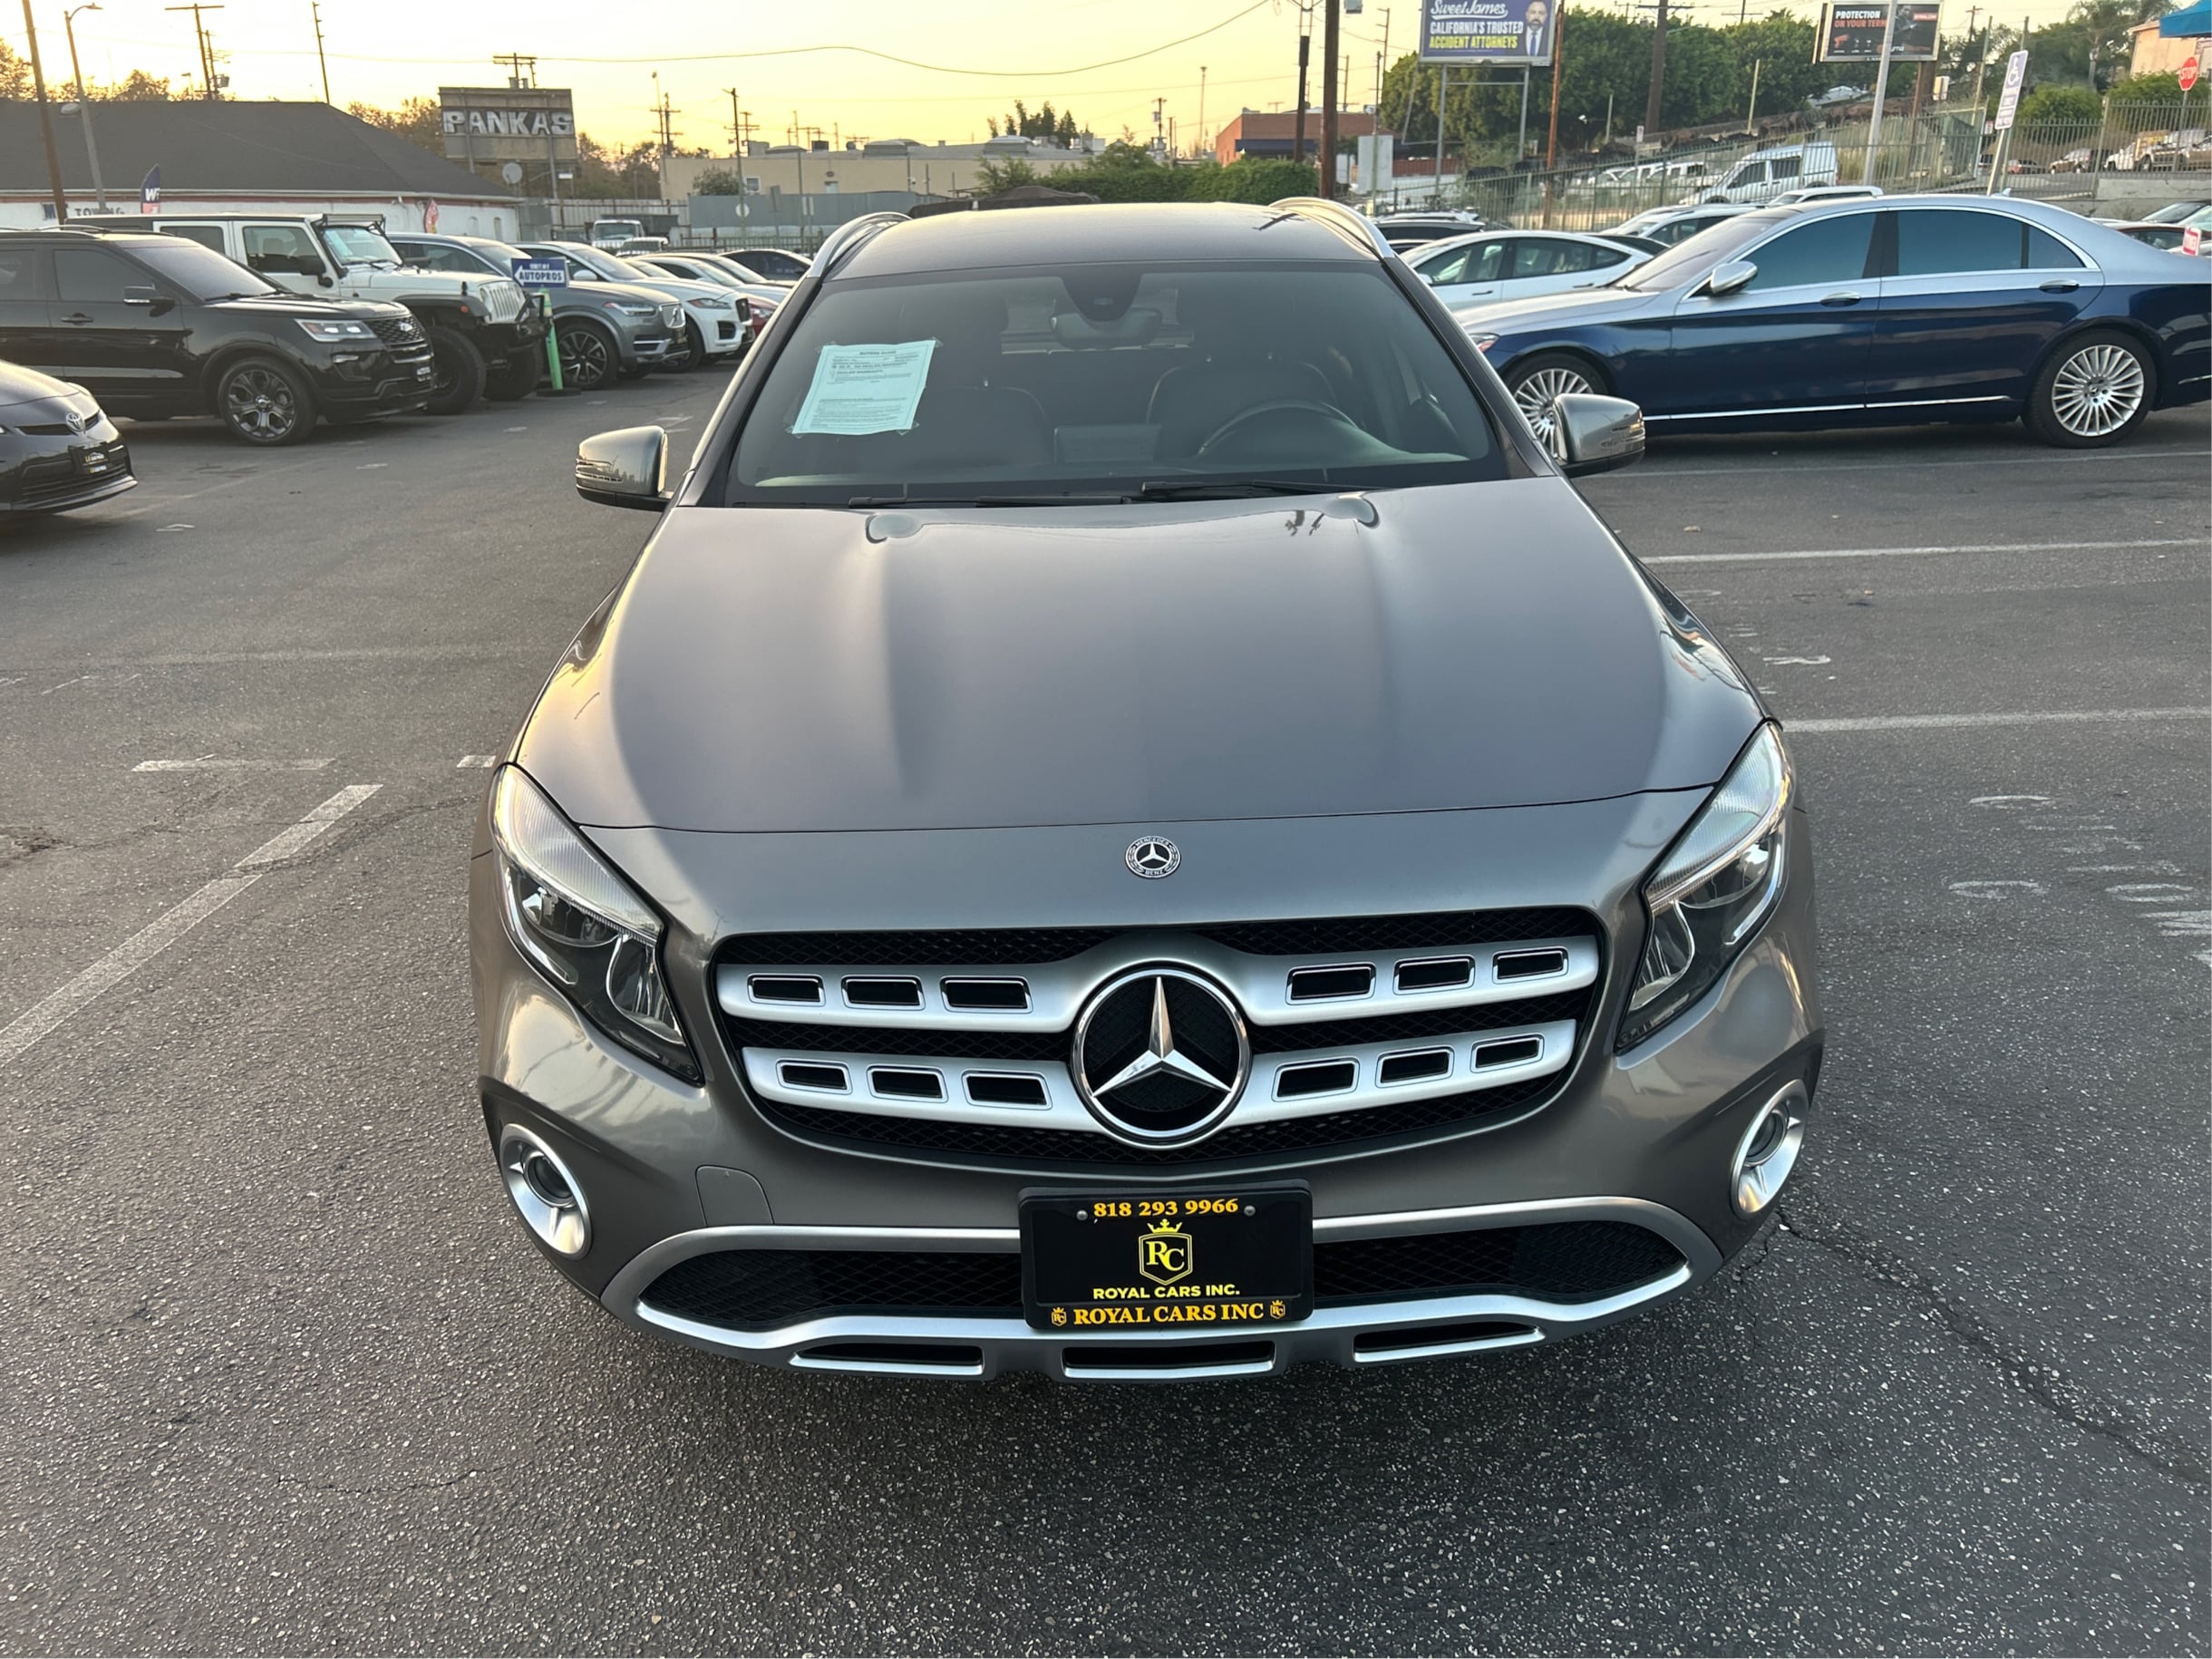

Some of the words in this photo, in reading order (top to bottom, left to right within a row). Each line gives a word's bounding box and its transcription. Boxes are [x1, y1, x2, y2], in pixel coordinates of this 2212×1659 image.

[1431, 0, 1468, 15] Sweet
[1465, 0, 1507, 15] James
[1835, 10, 1881, 20] PROTECTION
[1430, 21, 1485, 34] CALIFORNIA'S
[1487, 20, 1523, 34] TRUSTED
[1834, 20, 1846, 28] ON
[1847, 19, 1867, 28] YOUR
[1429, 36, 1469, 49] ACCIDENT
[1470, 35, 1518, 49] ATTORNEYS
[2180, 66, 2197, 81] STOP
[442, 110, 574, 135] PANKAS
[519, 271, 562, 281] AUTOPROS
[1093, 1201, 1132, 1218] 818
[1139, 1200, 1179, 1217] 293
[1185, 1198, 1239, 1215] 9966
[1146, 1240, 1185, 1271] RC
[1092, 1287, 1150, 1300] ROYAL
[1154, 1285, 1201, 1298] CARS
[1206, 1284, 1241, 1296] INC.
[1073, 1306, 1150, 1325] ROYAL
[1153, 1304, 1217, 1322] CARS
[1220, 1302, 1265, 1321] INC
